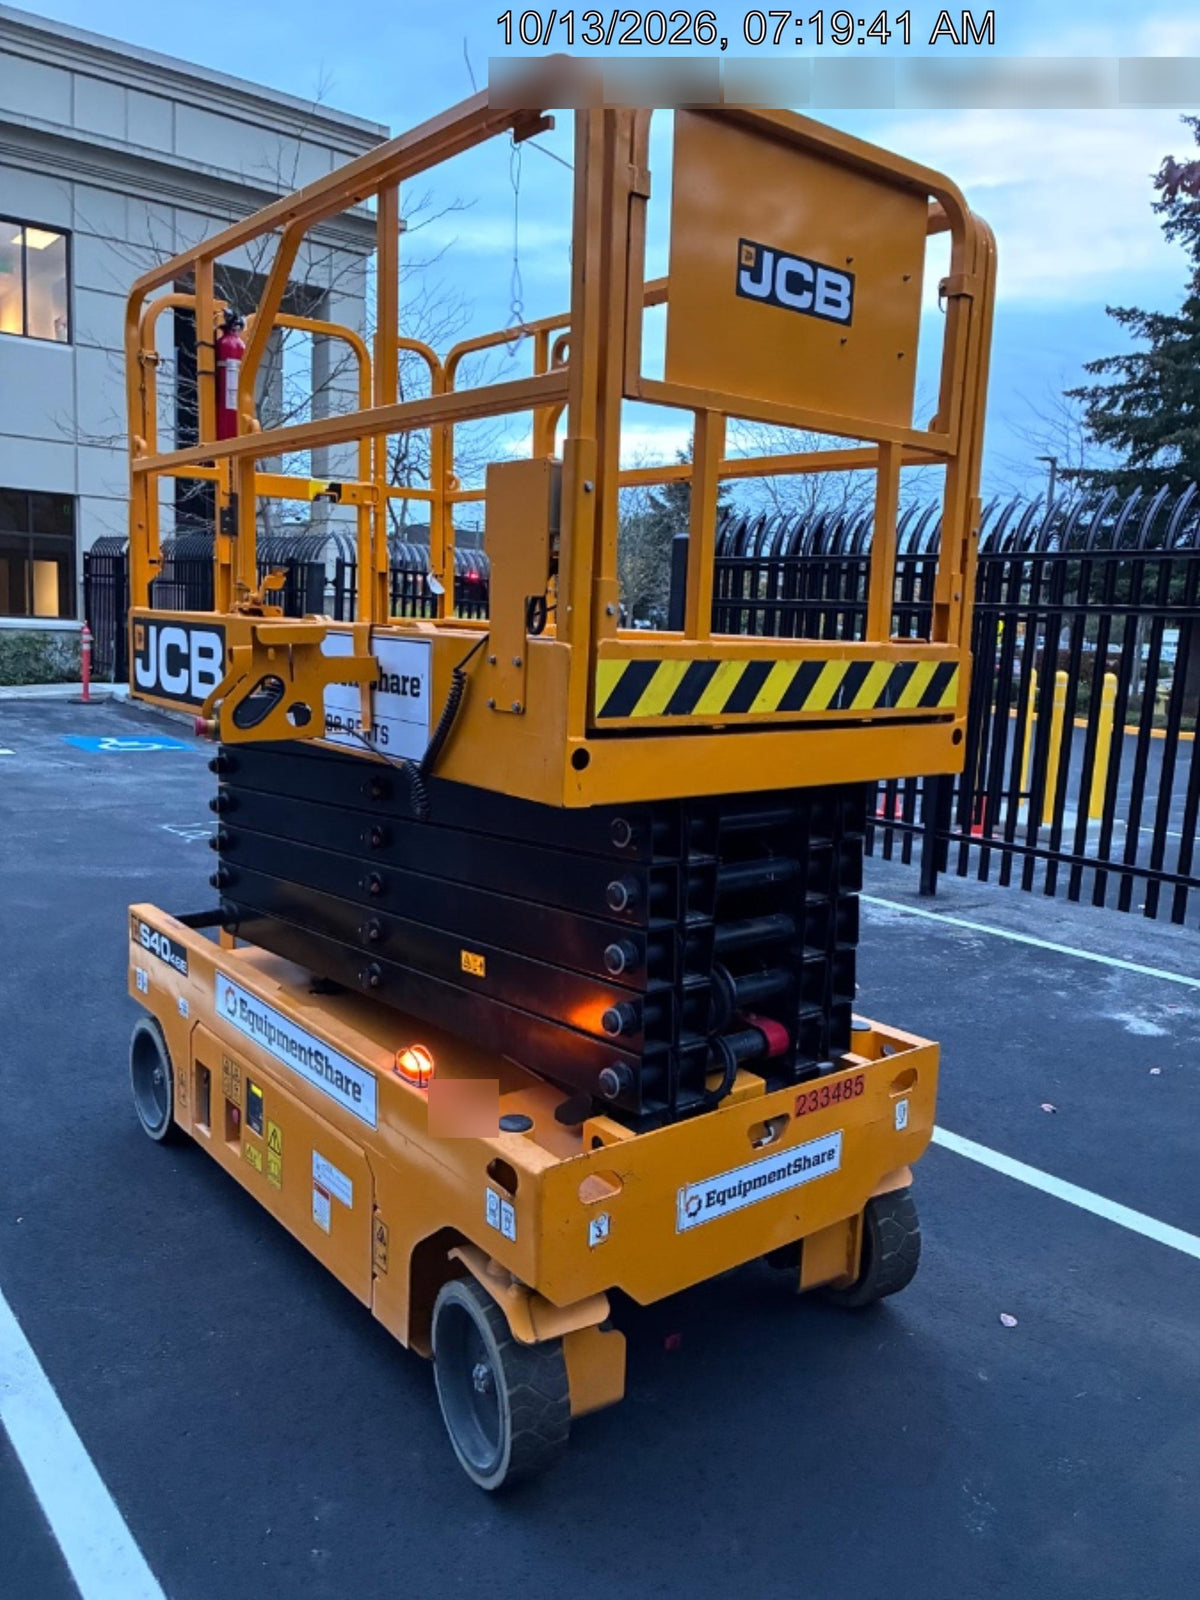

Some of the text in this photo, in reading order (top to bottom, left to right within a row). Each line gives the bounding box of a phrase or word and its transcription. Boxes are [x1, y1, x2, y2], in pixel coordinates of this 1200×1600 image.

[740, 250, 851, 320] JCB
[135, 625, 223, 699] JCB
[239, 998, 362, 1103] EquipmentShare
[796, 1074, 865, 1117] 233485
[705, 1147, 836, 1208] EquipmentShare
